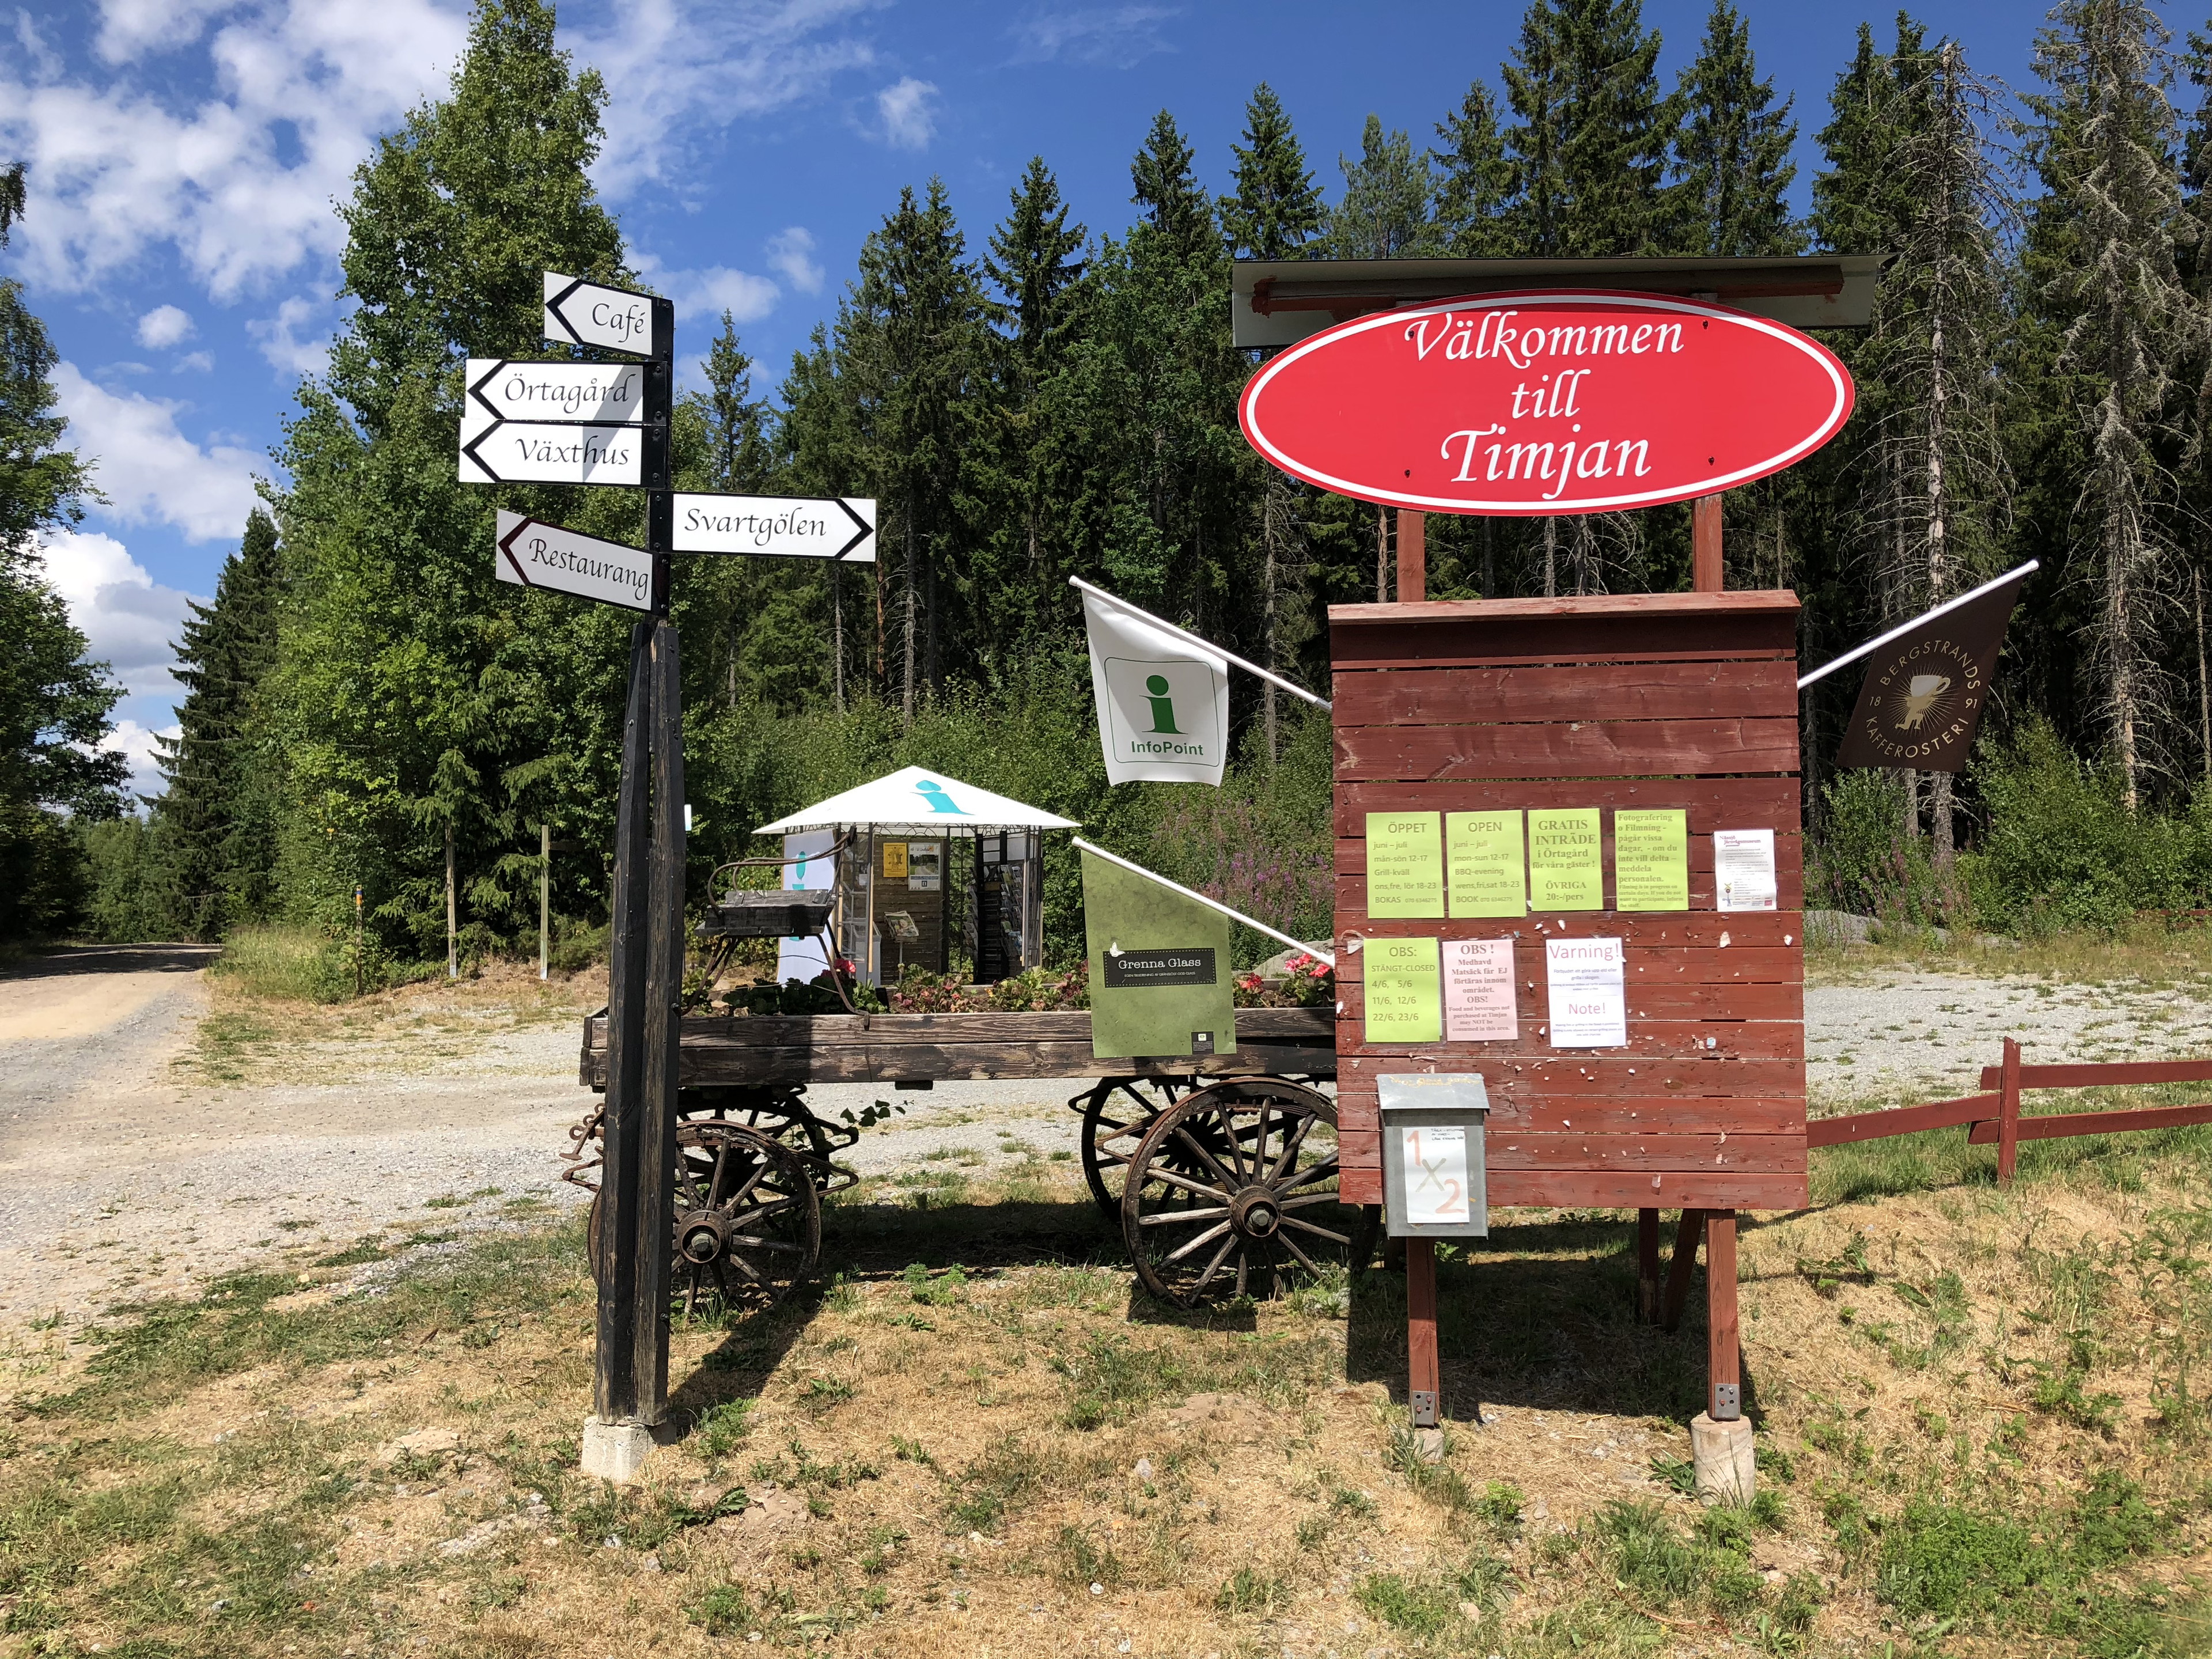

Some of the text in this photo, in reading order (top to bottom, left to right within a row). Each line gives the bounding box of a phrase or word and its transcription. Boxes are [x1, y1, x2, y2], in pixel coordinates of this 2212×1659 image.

[592, 304, 645, 342] Café
[1404, 311, 1684, 369] Välkommen
[505, 373, 636, 413] Örtagård
[1512, 369, 1590, 419] till
[516, 435, 630, 465] Växthus
[1440, 423, 1652, 499] Timjan
[684, 507, 826, 546] Svartgölen
[529, 538, 649, 600] Restaurang
[1880, 640, 1980, 690] BERGSTRANDS
[1869, 696, 1978, 709] 18 91
[1866, 717, 1968, 757] KAFFEROSTERI
[1131, 741, 1203, 756] InfoPoint
[1618, 814, 1673, 823] Fotografering
[1388, 821, 1427, 833] ÖPPET
[1468, 821, 1502, 832] OPEN
[1538, 820, 1588, 830] GRATIS
[1626, 824, 1661, 832] Filmning
[1535, 832, 1596, 845] INTRÄDE
[1618, 834, 1641, 843] pågår
[1373, 842, 1388, 850] juni
[1395, 841, 1407, 850] juli
[1453, 841, 1468, 849] juni
[1475, 840, 1488, 849] juli
[1537, 848, 1588, 859] i Örtagård
[1566, 861, 1590, 870] gäster
[1455, 868, 1504, 876] BBQ-evening
[1546, 880, 1586, 889] ÖVRIGA
[1619, 875, 1664, 884] personalen.
[1546, 893, 1584, 902] 20:-/pers
[1389, 947, 1417, 957] OBS:
[1460, 944, 1487, 955] OBS
[1549, 943, 1619, 961] Varning!
[1119, 959, 1201, 969] Grenna Glass
[1372, 980, 1412, 988] 4/6, 5/6
[1372, 997, 1416, 1005] 11/6, 12/6
[1569, 1002, 1606, 1014] Note!
[1373, 1013, 1419, 1022] 22/6, 23/6
[1407, 1130, 1421, 1166] 1
[1435, 1179, 1466, 1213] 2
